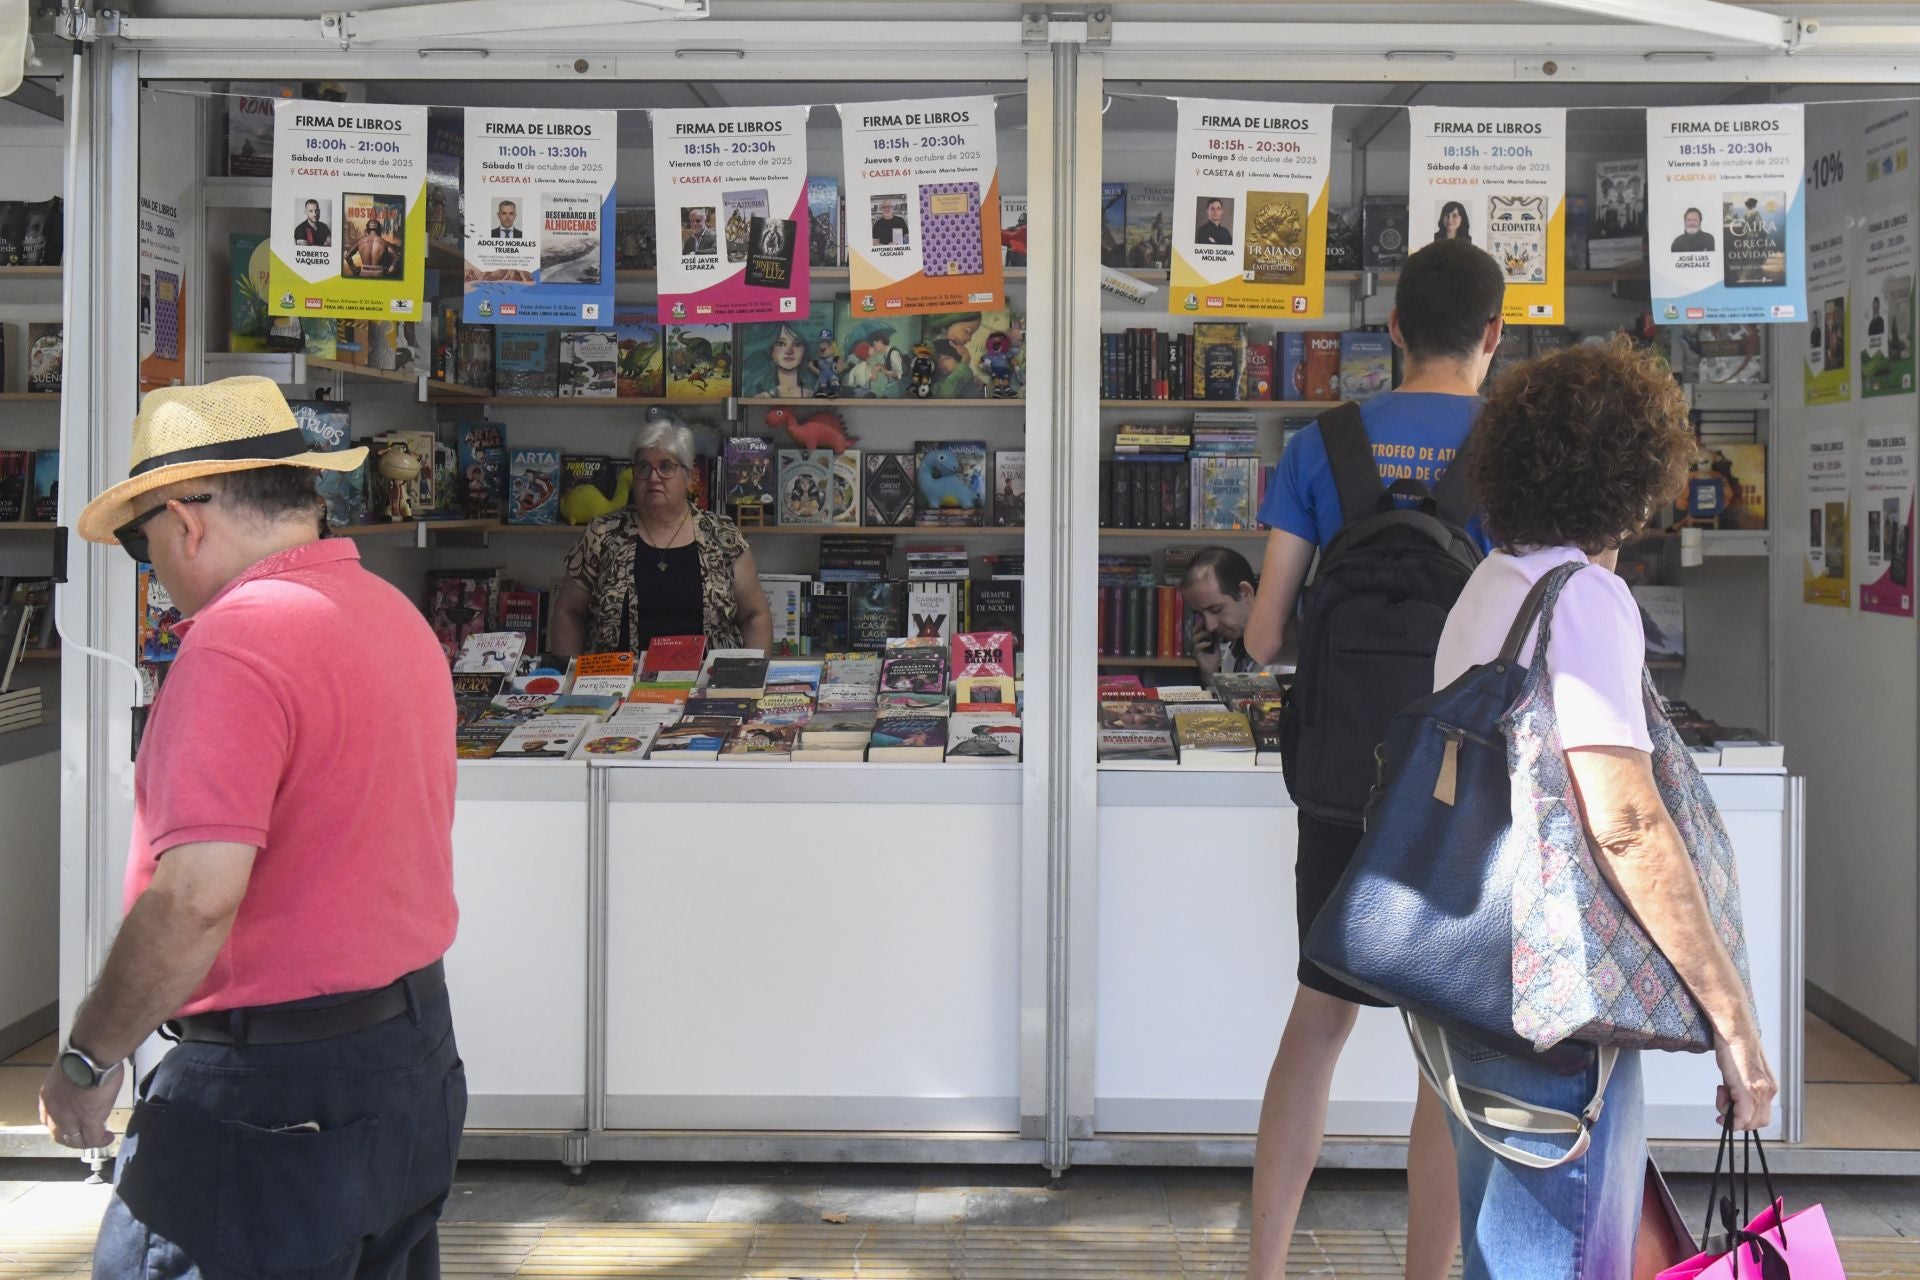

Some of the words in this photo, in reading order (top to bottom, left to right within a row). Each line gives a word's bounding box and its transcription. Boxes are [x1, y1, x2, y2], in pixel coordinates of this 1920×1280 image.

[295, 116, 334, 128] FIRMA
[338, 117, 353, 128] DE
[356, 119, 402, 131] LIBROS
[863, 115, 903, 127] FIRMA
[906, 114, 921, 125] DE
[924, 111, 969, 123] LIBROS
[1202, 116, 1241, 128] FIRMA
[1244, 117, 1260, 128] DE
[1264, 118, 1309, 130] LIBROS
[485, 123, 524, 134] FIRMA
[528, 124, 543, 134] DE
[547, 124, 592, 136] LIBROS
[676, 123, 715, 134] FIRMA
[718, 122, 734, 133] DE
[737, 121, 782, 132] LIBROS
[1434, 122, 1473, 133] FIRMA
[1477, 123, 1493, 133] DE
[1496, 123, 1542, 134] LIBROS
[1671, 122, 1711, 133] FIRMA
[1715, 121, 1729, 132] DE
[1733, 120, 1779, 132] LIBROS
[306, 138, 346, 150] 18:00h
[358, 141, 400, 153] 21:00h
[684, 143, 720, 154] 18:15h
[732, 141, 775, 153] 20:30h
[873, 138, 910, 150] 18:15h
[921, 135, 965, 148] 20:30h
[1208, 139, 1244, 151] 18:15h
[1256, 141, 1300, 153] 20:30h
[1680, 144, 1716, 155] 18:15h
[1728, 142, 1772, 154] 20:30h
[499, 145, 536, 157] 11:00h
[548, 147, 587, 158] 13:30h
[1443, 146, 1479, 157] 18:15h
[1491, 146, 1533, 157] 21:00h
[292, 154, 323, 162] Sábado
[333, 156, 343, 164] de
[346, 157, 376, 165] octubre
[379, 158, 389, 166] de
[392, 159, 413, 167] 2025
[669, 160, 701, 168] Viernes
[703, 159, 711, 167] 10
[714, 158, 723, 167] de
[726, 158, 756, 166] octubre
[759, 157, 769, 166] de
[771, 157, 792, 165] 2025
[864, 156, 892, 164] Jueves
[895, 155, 900, 163] 9
[902, 154, 913, 162] de
[915, 153, 944, 162] octubre
[947, 152, 957, 160] de
[959, 152, 981, 160] 2025
[1191, 152, 1228, 162] Domingo
[1238, 154, 1248, 162] de
[1250, 155, 1280, 163] octubre
[1283, 156, 1293, 164] de
[1296, 156, 1317, 164] 2025
[1668, 160, 1701, 168] Viernes
[1710, 158, 1720, 167] de
[1723, 158, 1752, 166] octubre
[1755, 157, 1765, 166] de
[1768, 157, 1790, 165] 2025
[298, 168, 328, 176] CASETA
[538, 163, 567, 171] octubre
[1203, 169, 1234, 177] CASETA
[1427, 163, 1460, 171] Sábado
[1471, 163, 1481, 171] de
[1483, 163, 1513, 171] octubre
[1516, 163, 1526, 171] de
[489, 176, 520, 184] CASETA
[523, 176, 531, 184] 61
[680, 176, 711, 184] CASETA
[1674, 174, 1705, 182] CASETA
[152, 202, 158, 211] DE
[159, 204, 177, 218] LIBROS
[545, 211, 584, 220] DESEMBARCO
[587, 212, 596, 220] DE
[545, 220, 597, 232] ALHUCEMAS
[1491, 223, 1541, 232] CLEOPATRA
[1730, 219, 1777, 237] CAIRA
[1734, 239, 1776, 248] GRECIA
[1248, 246, 1301, 257] TRAJANO
[295, 258, 330, 266] VAQUERO
[681, 256, 696, 264] JOSÉ
[765, 268, 785, 280] LUZ
[1312, 339, 1340, 349] MOM
[1371, 444, 1415, 459] TROFEO
[1420, 447, 1433, 460] DE
[1416, 466, 1430, 480] DE
[964, 649, 1002, 658] SEXO
